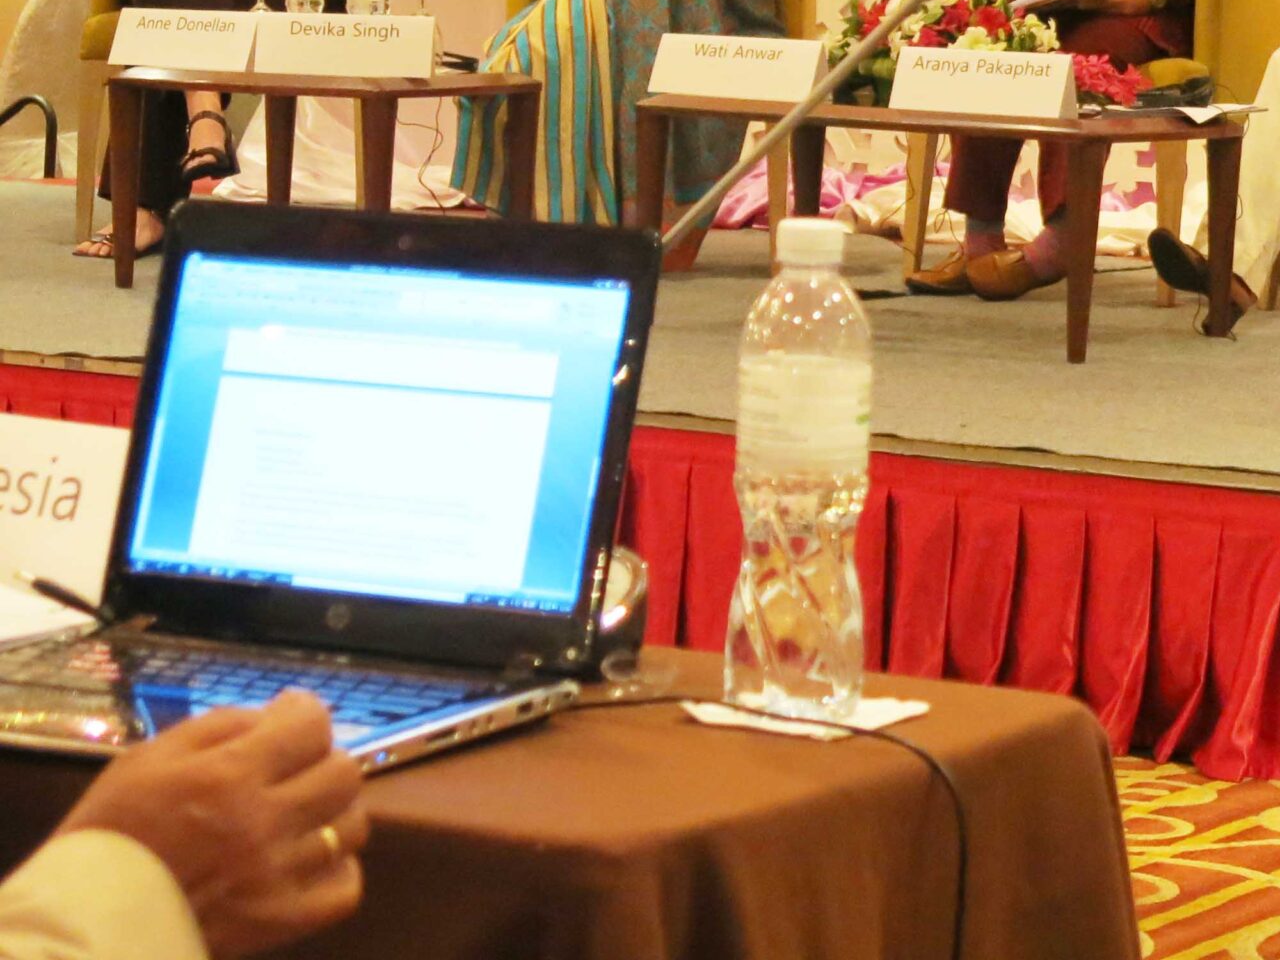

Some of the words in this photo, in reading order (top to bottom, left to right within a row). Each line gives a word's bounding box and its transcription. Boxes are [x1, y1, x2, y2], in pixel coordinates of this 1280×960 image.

[135, 15, 173, 31] Anne
[175, 17, 236, 33] Donellan
[289, 19, 347, 37] Devika
[352, 21, 401, 41] Singh
[693, 42, 729, 59] Wati
[732, 44, 785, 61] Anwar
[912, 54, 970, 75] Aranya
[976, 58, 1053, 79] Pakaphat
